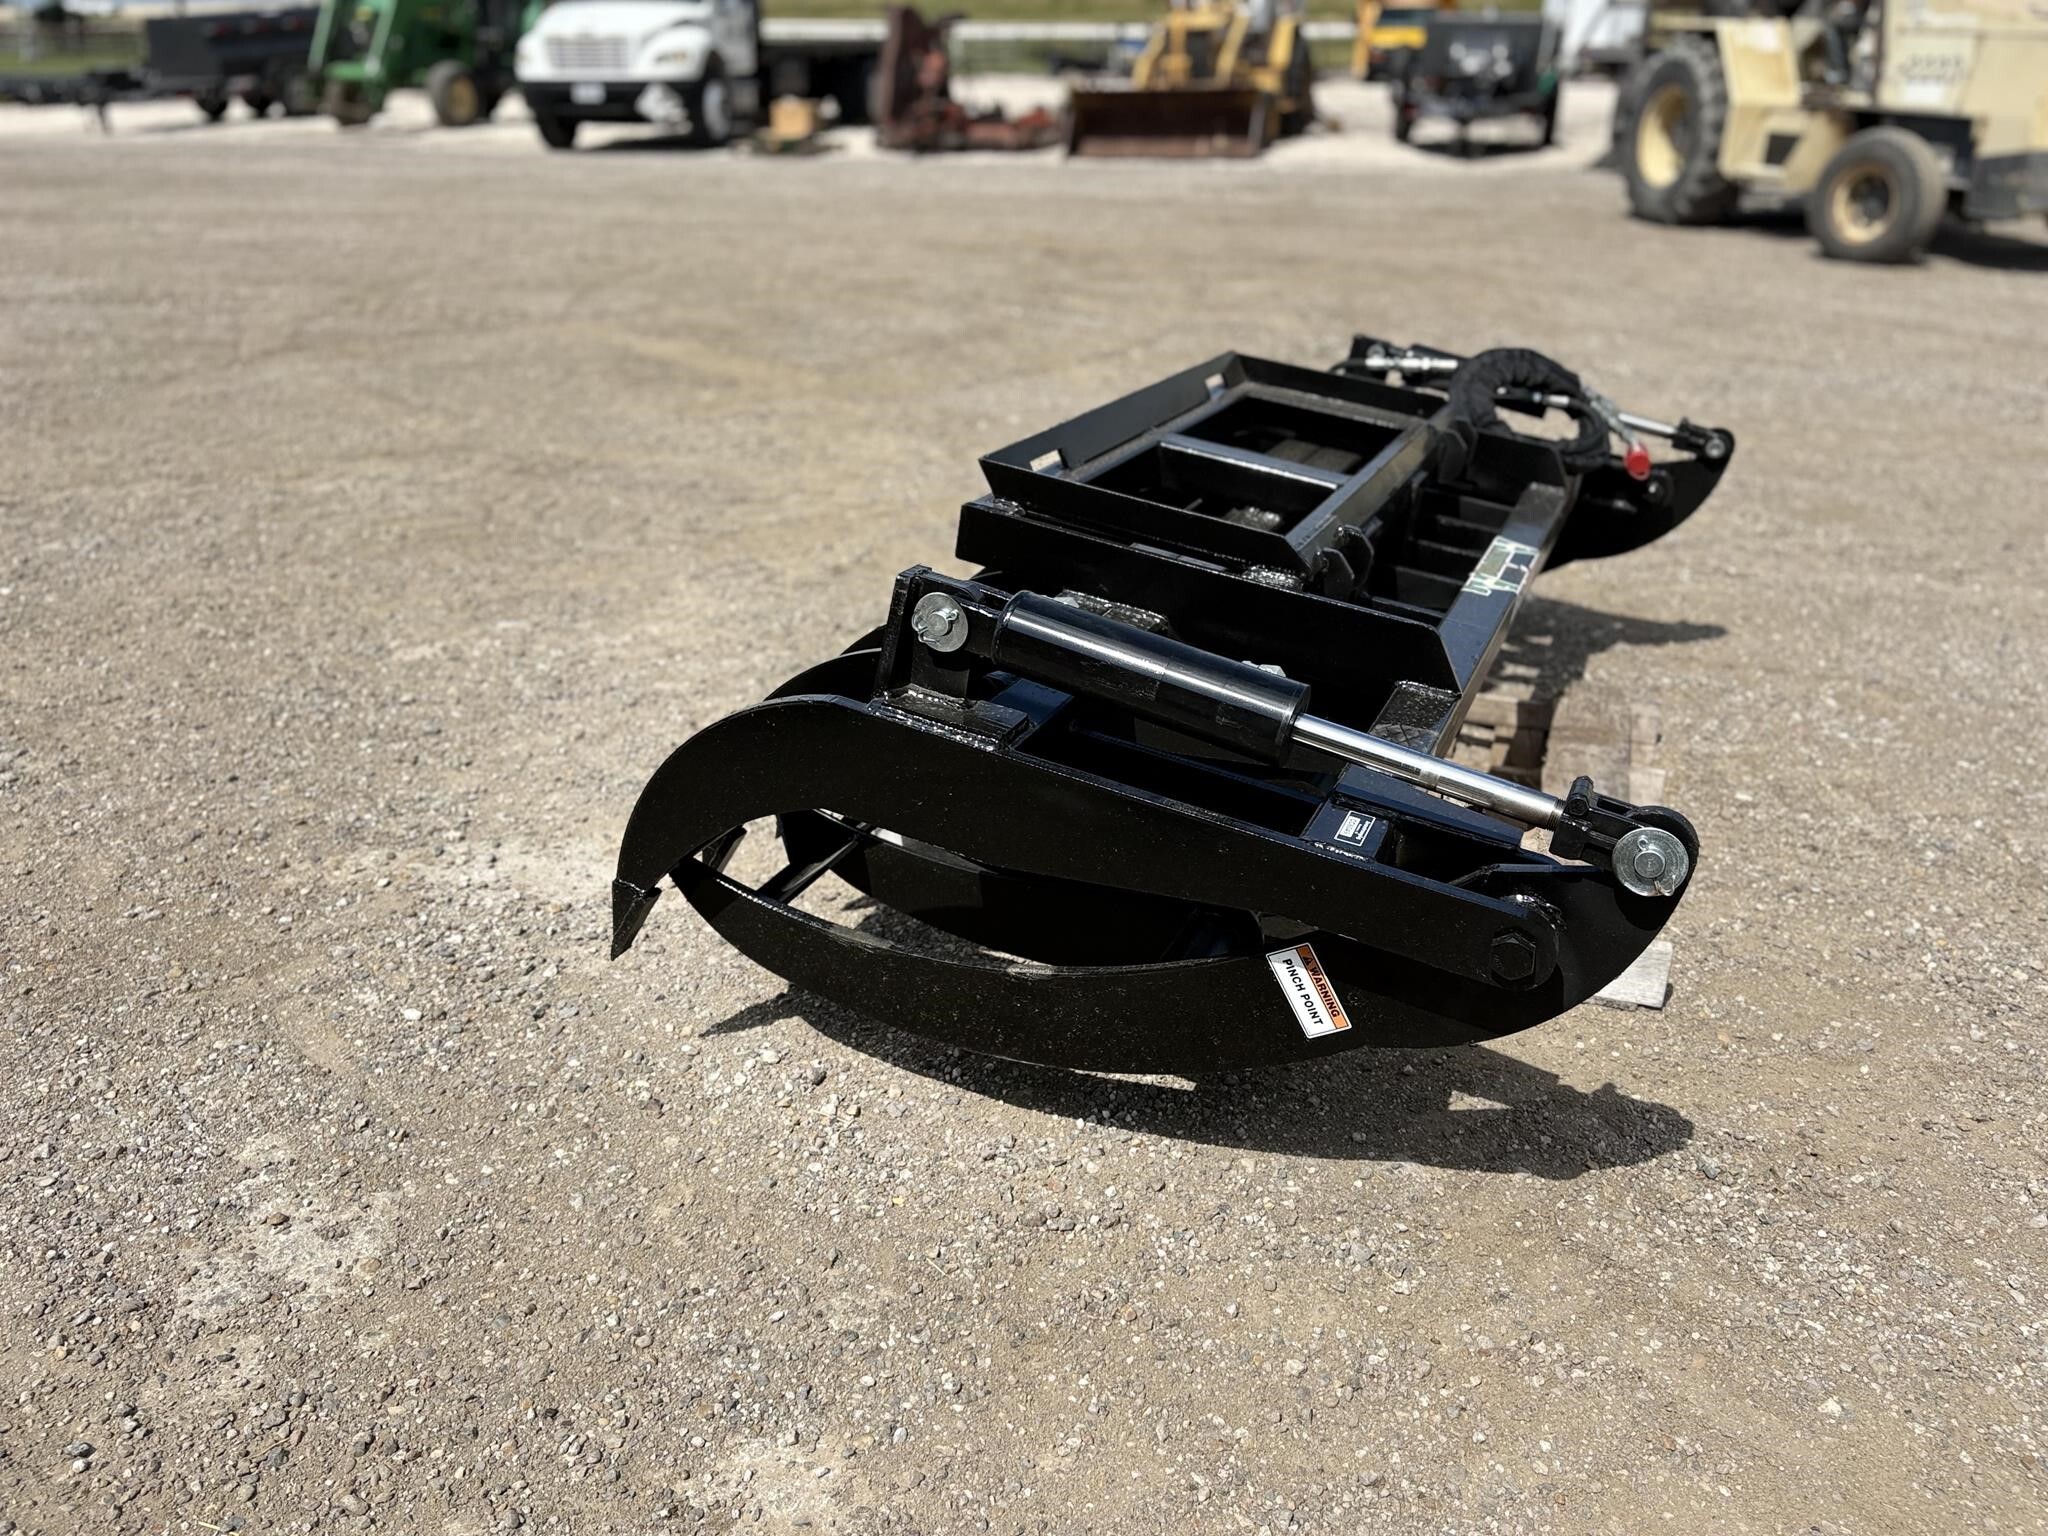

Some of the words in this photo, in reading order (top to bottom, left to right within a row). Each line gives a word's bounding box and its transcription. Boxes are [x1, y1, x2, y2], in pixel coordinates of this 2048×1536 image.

[1282, 958, 1305, 991] PINCH
[1300, 994, 1323, 1025] POINT
[1310, 967, 1340, 1017] WARNING
